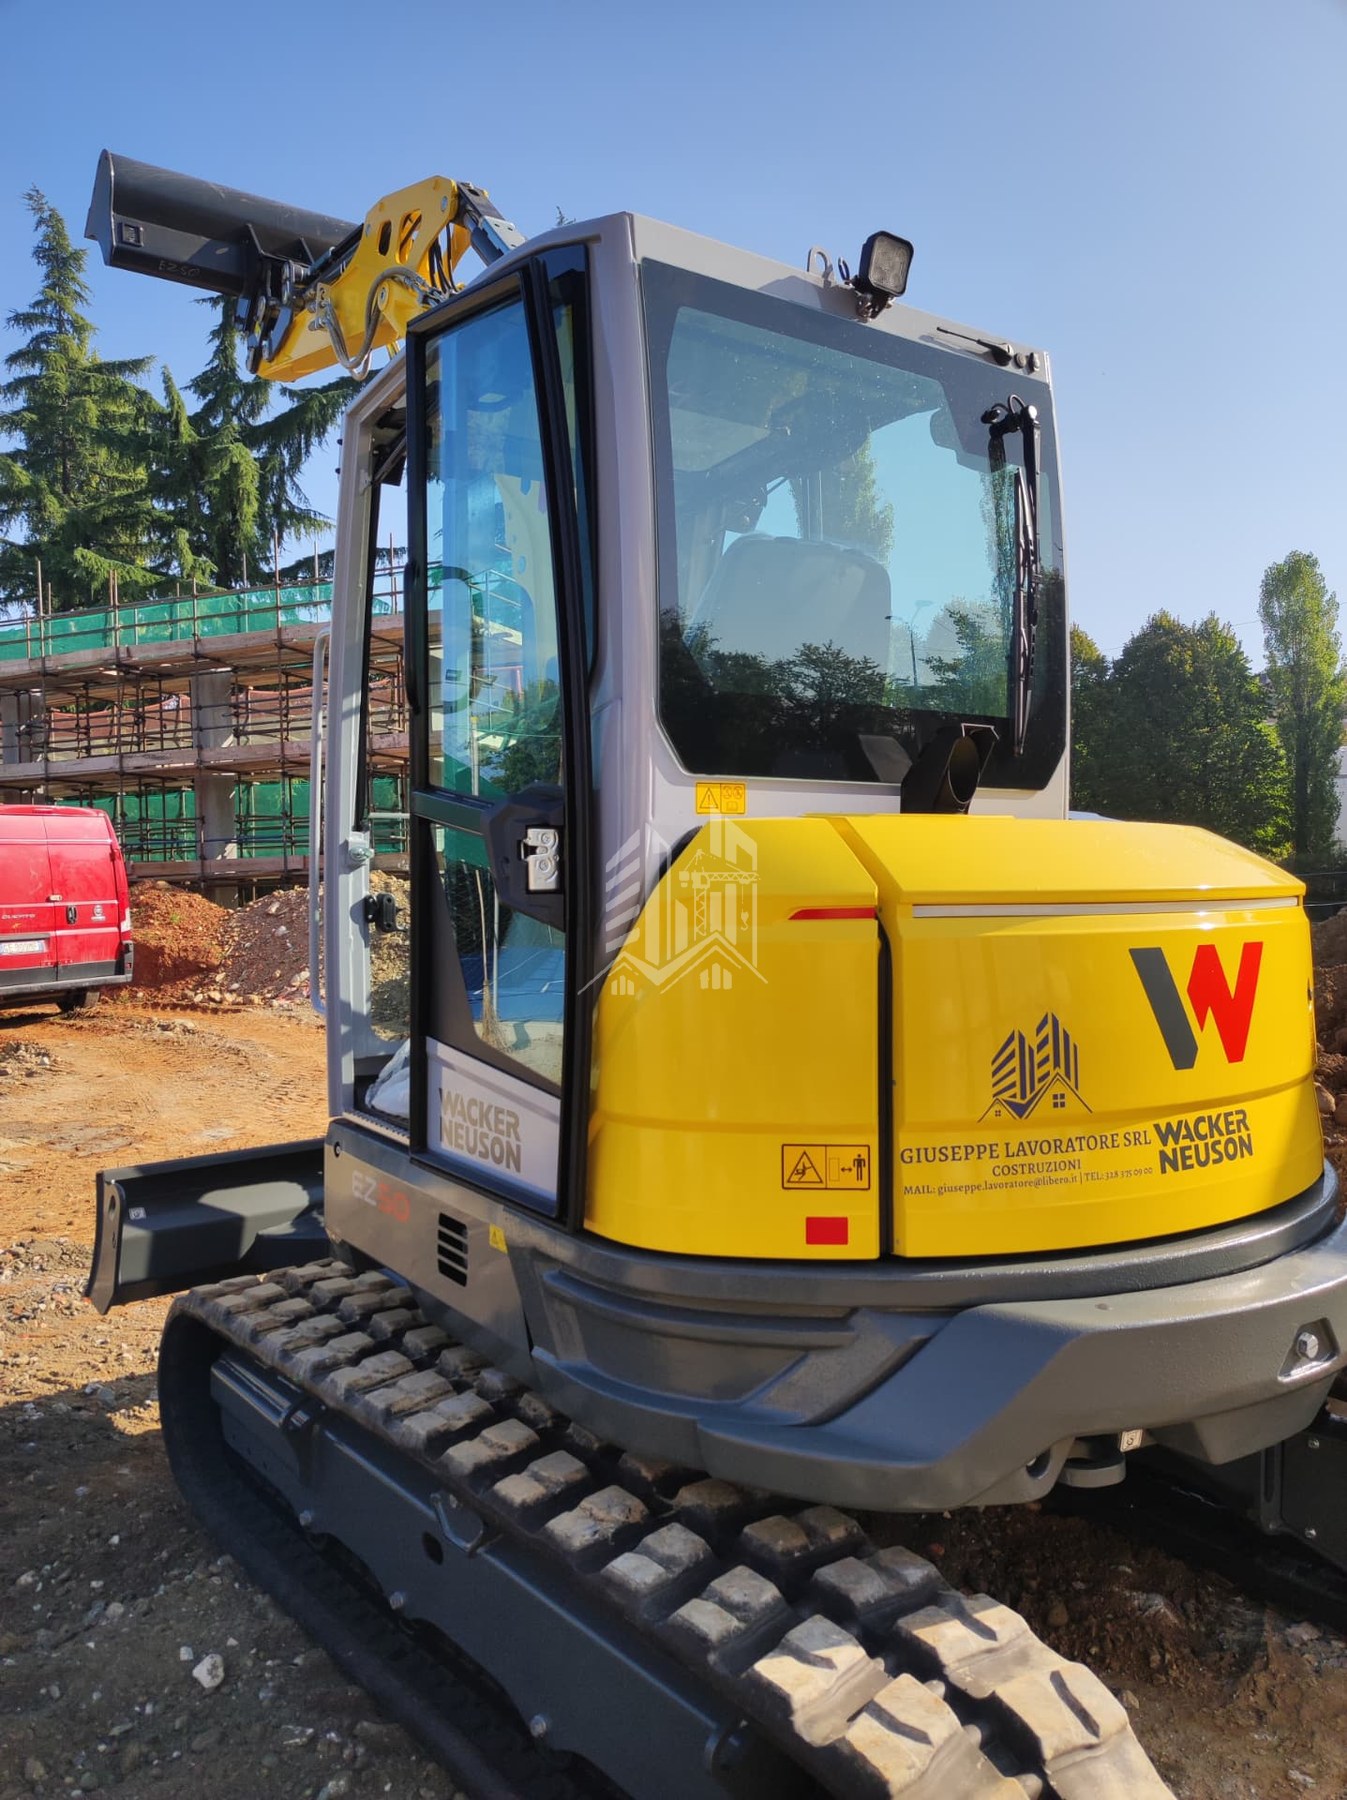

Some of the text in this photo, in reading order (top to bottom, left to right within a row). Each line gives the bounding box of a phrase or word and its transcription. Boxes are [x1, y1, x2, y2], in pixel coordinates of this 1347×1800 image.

[439, 1087, 521, 1142] WACKER
[1153, 1109, 1250, 1147] WACKER
[440, 1116, 521, 1173] NEUSON
[900, 1130, 1152, 1164] GIUSEPPE LAVORATORE SRL
[1158, 1133, 1254, 1174] NEUSON
[903, 1184, 936, 1196] MAIL:
[938, 1175, 1078, 1196] giuseppe.lavoratore@libero.it
[992, 1158, 1082, 1177] COSTRUZIONI
